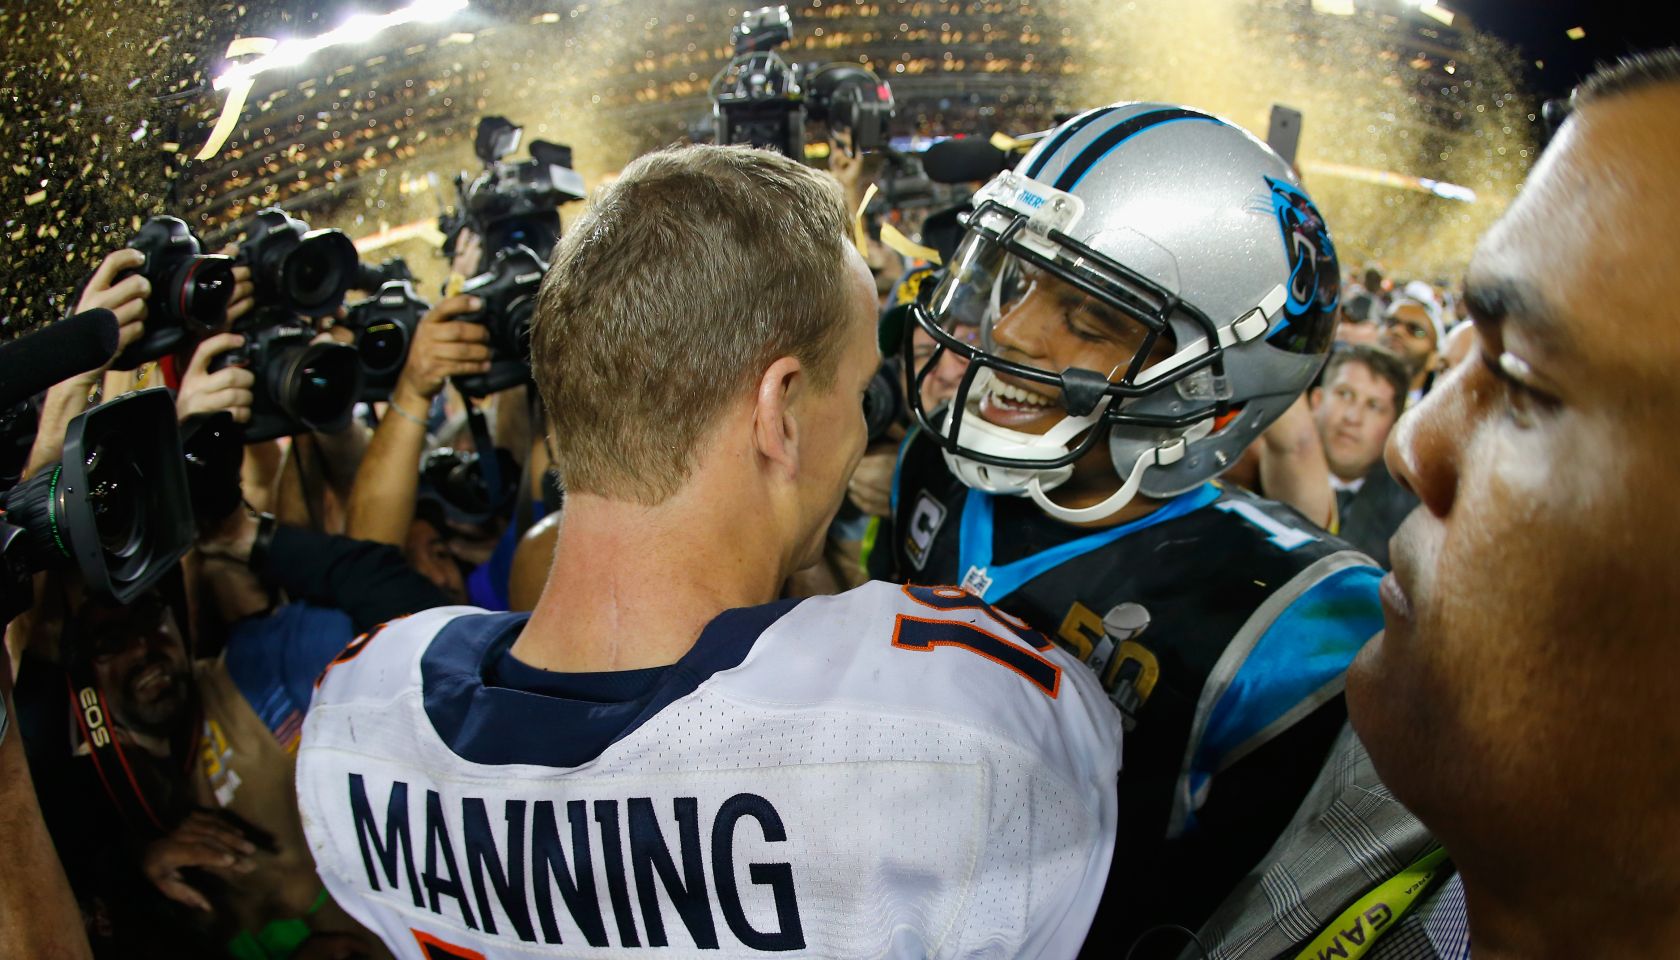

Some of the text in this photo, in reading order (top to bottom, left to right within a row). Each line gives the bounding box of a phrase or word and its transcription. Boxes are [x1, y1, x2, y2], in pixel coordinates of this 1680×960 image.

[911, 498, 940, 549] C
[1214, 500, 1314, 552] 1
[890, 584, 1062, 700] 18
[80, 687, 110, 747] EOS
[349, 773, 806, 951] MANNING
[1309, 902, 1393, 960] GAM
